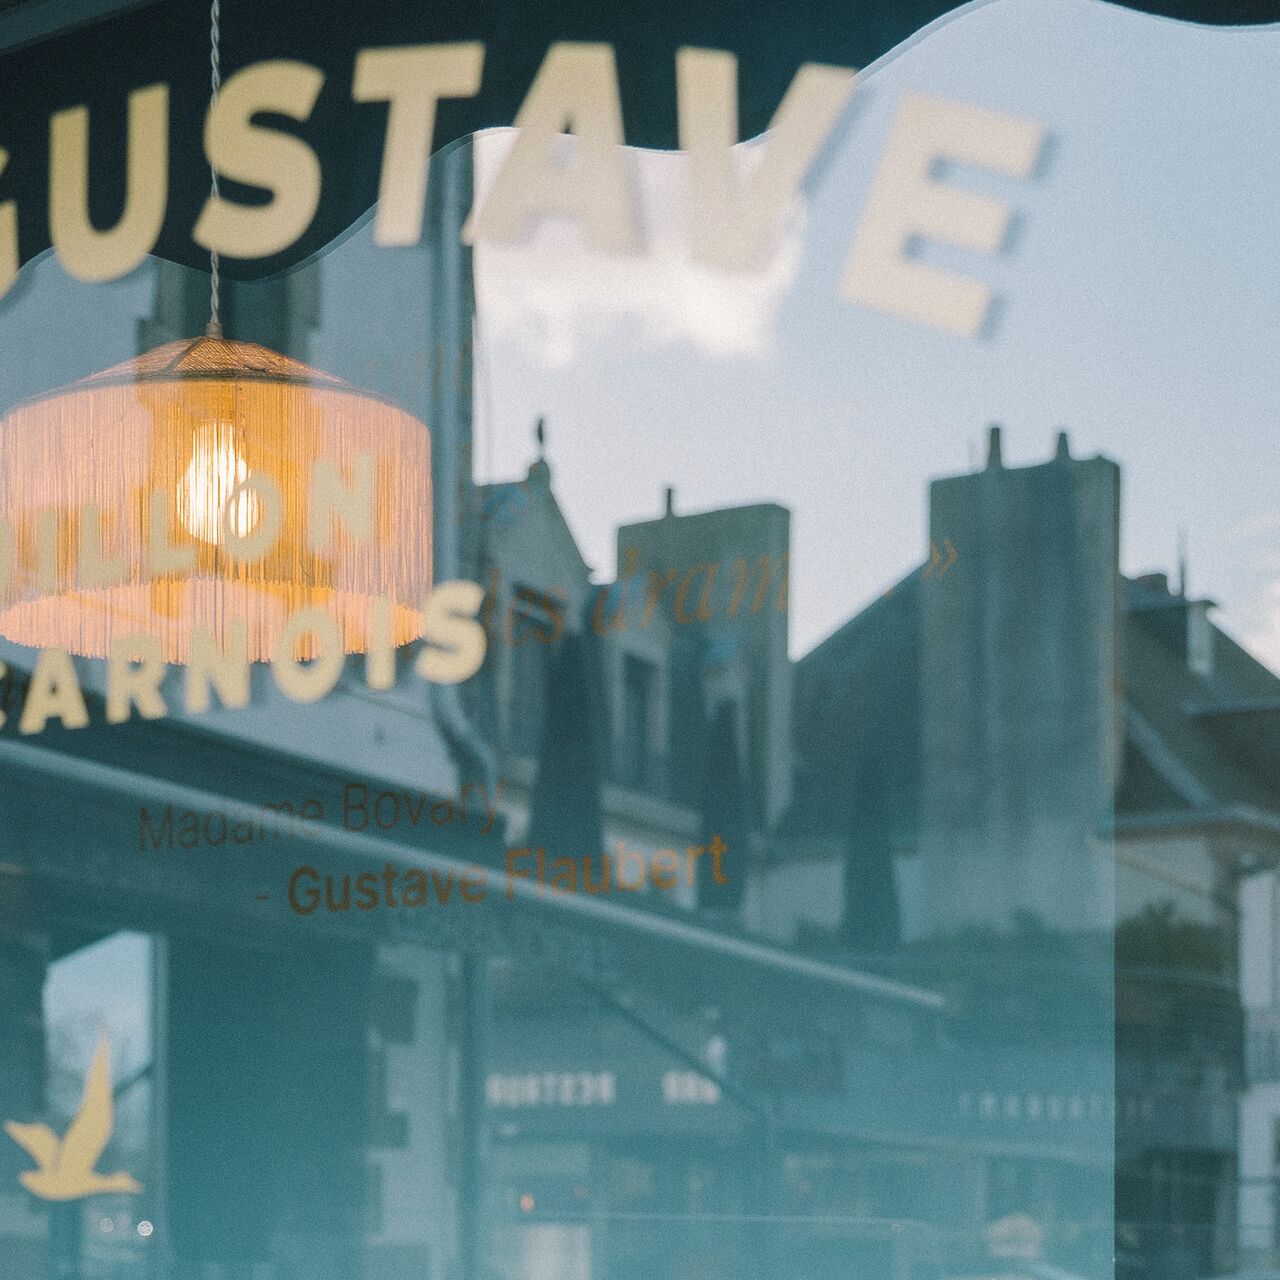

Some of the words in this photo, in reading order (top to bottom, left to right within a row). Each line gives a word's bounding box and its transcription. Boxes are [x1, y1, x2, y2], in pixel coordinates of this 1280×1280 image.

[138, 793, 326, 854] Madame
[341, 779, 508, 843] Bovary
[287, 864, 488, 916] Gustave
[505, 834, 731, 900] Flaubert
